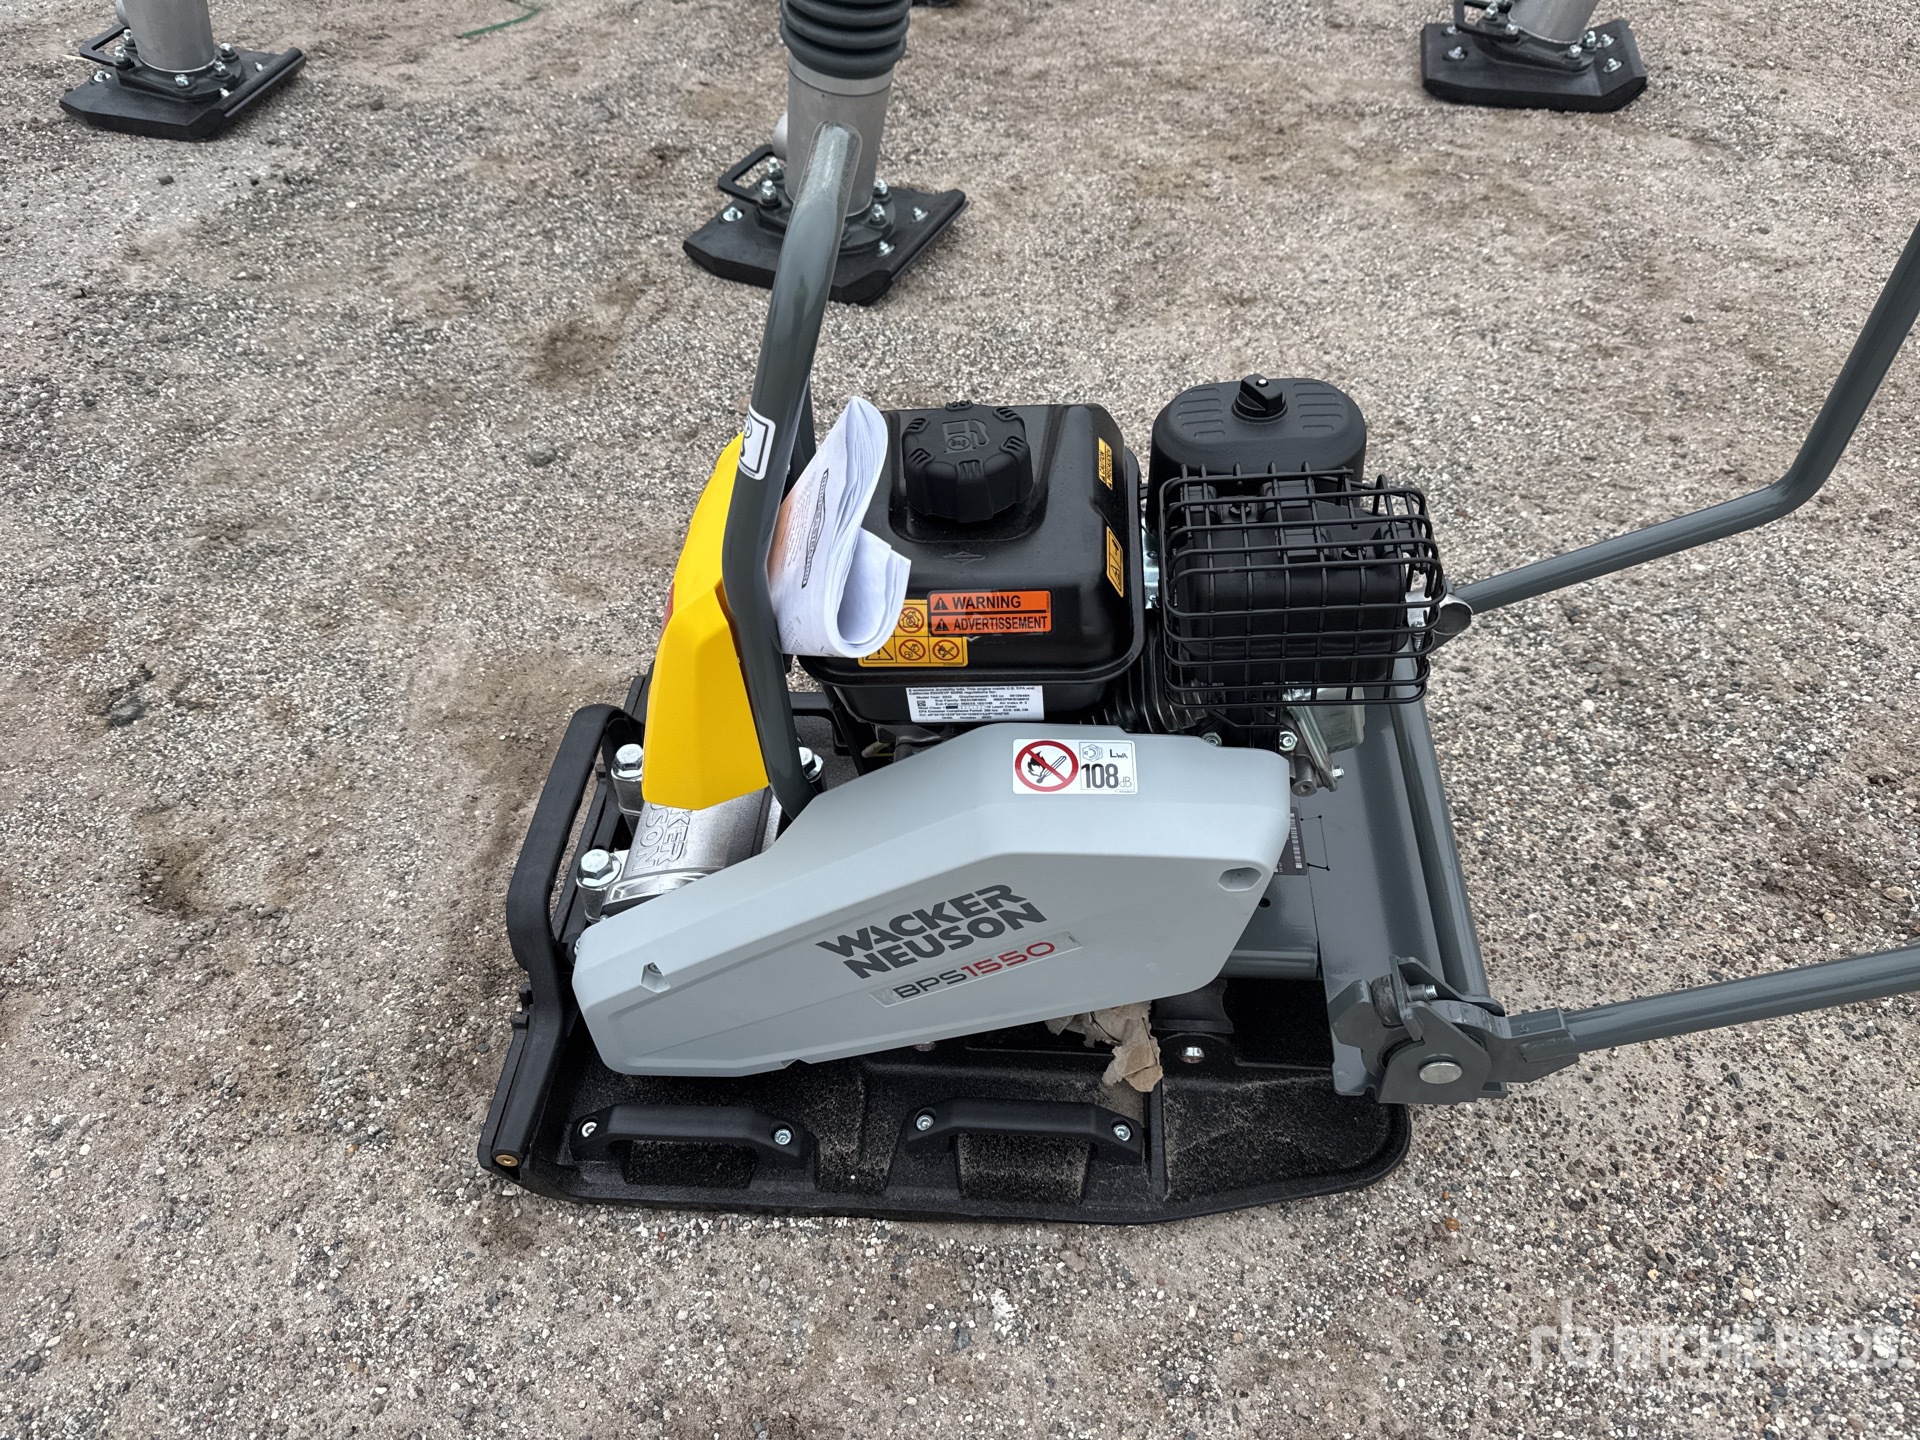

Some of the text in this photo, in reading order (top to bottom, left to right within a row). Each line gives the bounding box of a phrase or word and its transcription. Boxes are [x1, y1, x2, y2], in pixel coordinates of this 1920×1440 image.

[952, 595, 1021, 609] WARNING
[953, 616, 1048, 631] ADVERTISSEMENT
[1080, 763, 1132, 788] 108 dB
[815, 884, 1028, 958] WACKER
[843, 902, 1048, 979] NEUSON
[892, 941, 1056, 999] BPS1550
